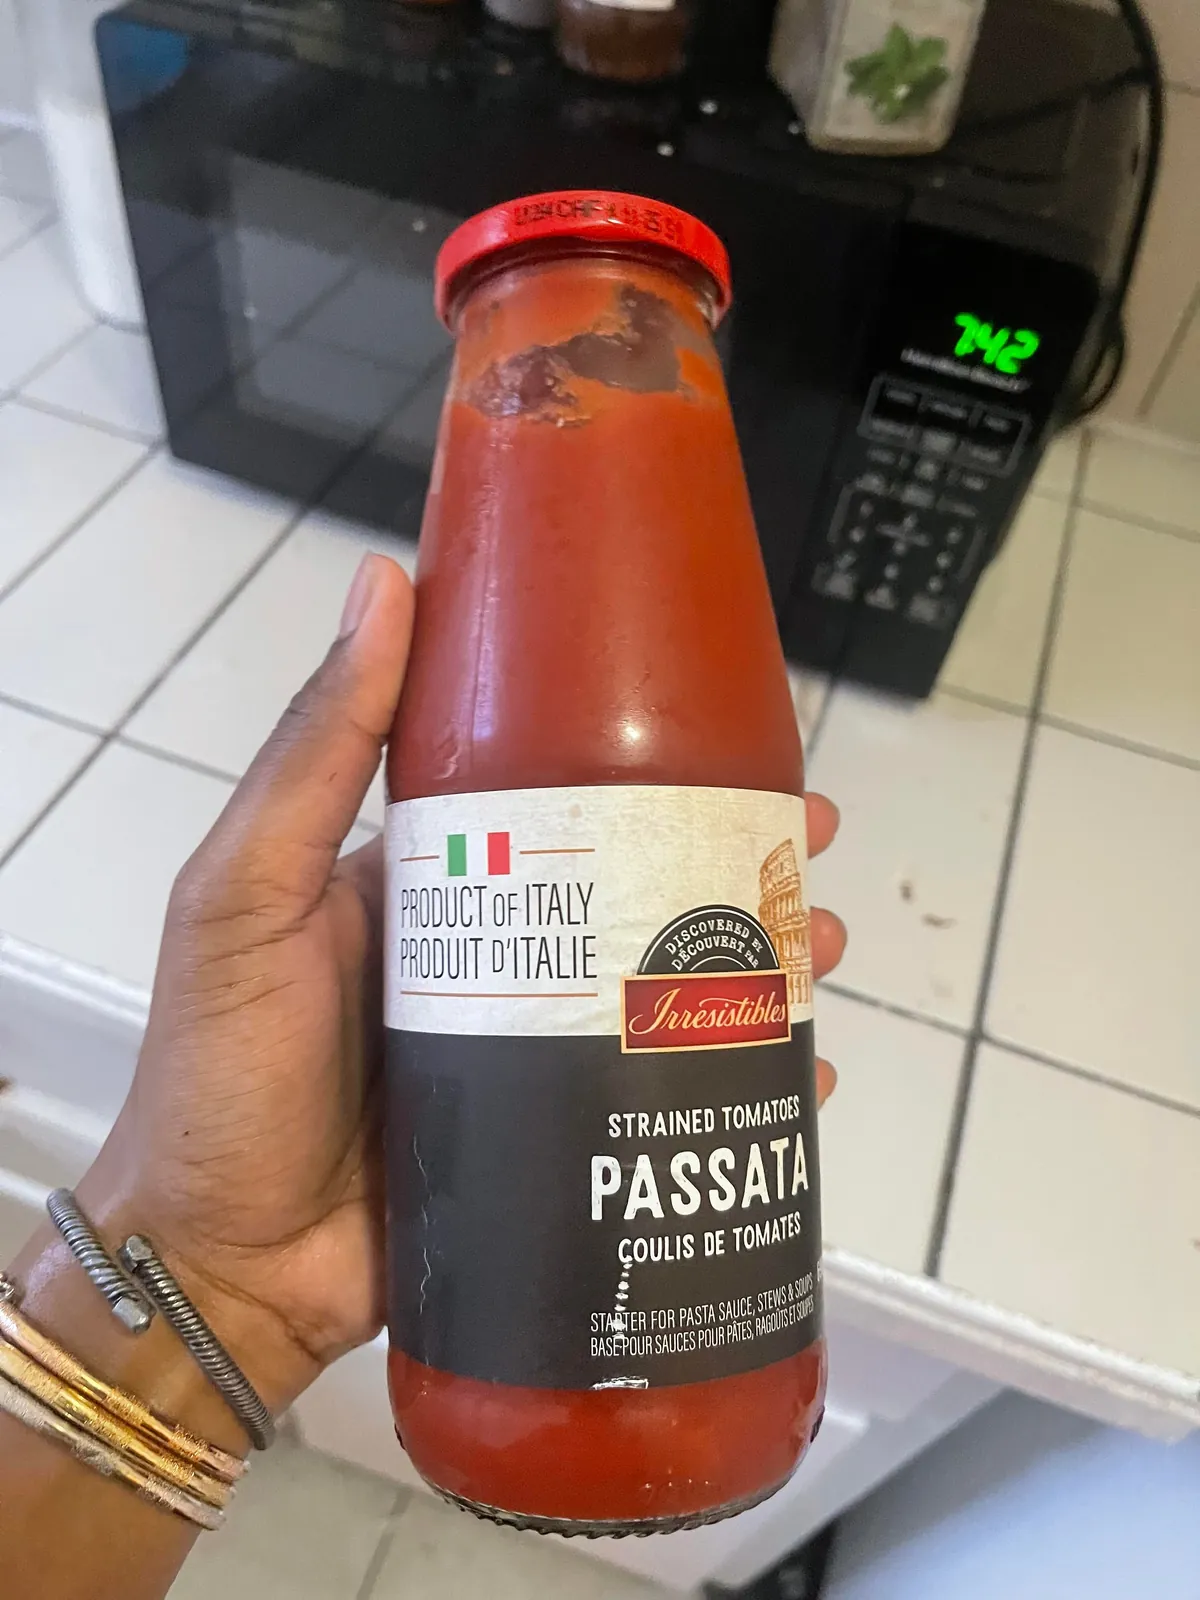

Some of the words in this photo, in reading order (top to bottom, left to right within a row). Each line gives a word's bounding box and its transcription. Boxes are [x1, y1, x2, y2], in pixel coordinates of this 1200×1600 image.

[401, 886, 488, 928] PRODUCT
[493, 893, 518, 926] OF
[526, 882, 594, 926] ITALY
[400, 937, 484, 979] PRODUIT
[492, 936, 598, 979] D'ITALIE
[665, 918, 751, 955] DISCOVERED
[751, 937, 763, 953] BY
[671, 935, 746, 971] DÉCOUVERT
[744, 951, 759, 969] PAR
[628, 987, 786, 1035] Irresistibles
[608, 1108, 715, 1138] STRAINED
[722, 1094, 800, 1131] TOMATOES
[591, 1132, 809, 1221] PASSATA
[704, 1230, 725, 1257] DE
[733, 1211, 801, 1252] TOMATES
[590, 1311, 647, 1333] STARTER
[651, 1309, 676, 1330] FOR
[679, 1304, 716, 1328] PASTA
[718, 1296, 756, 1322] SAUCE,
[757, 1285, 787, 1312] STEWS
[787, 1283, 794, 1302] &
[794, 1272, 813, 1298] SOUPS
[590, 1337, 620, 1357] BASE
[622, 1335, 653, 1356] POUR
[654, 1331, 696, 1354] SAUCES
[698, 1327, 725, 1350] POUR
[726, 1320, 754, 1344] PÂTES,
[755, 1308, 789, 1337] RAGOÛTS
[789, 1304, 797, 1326] ET
[796, 1294, 814, 1321] SOUPES
